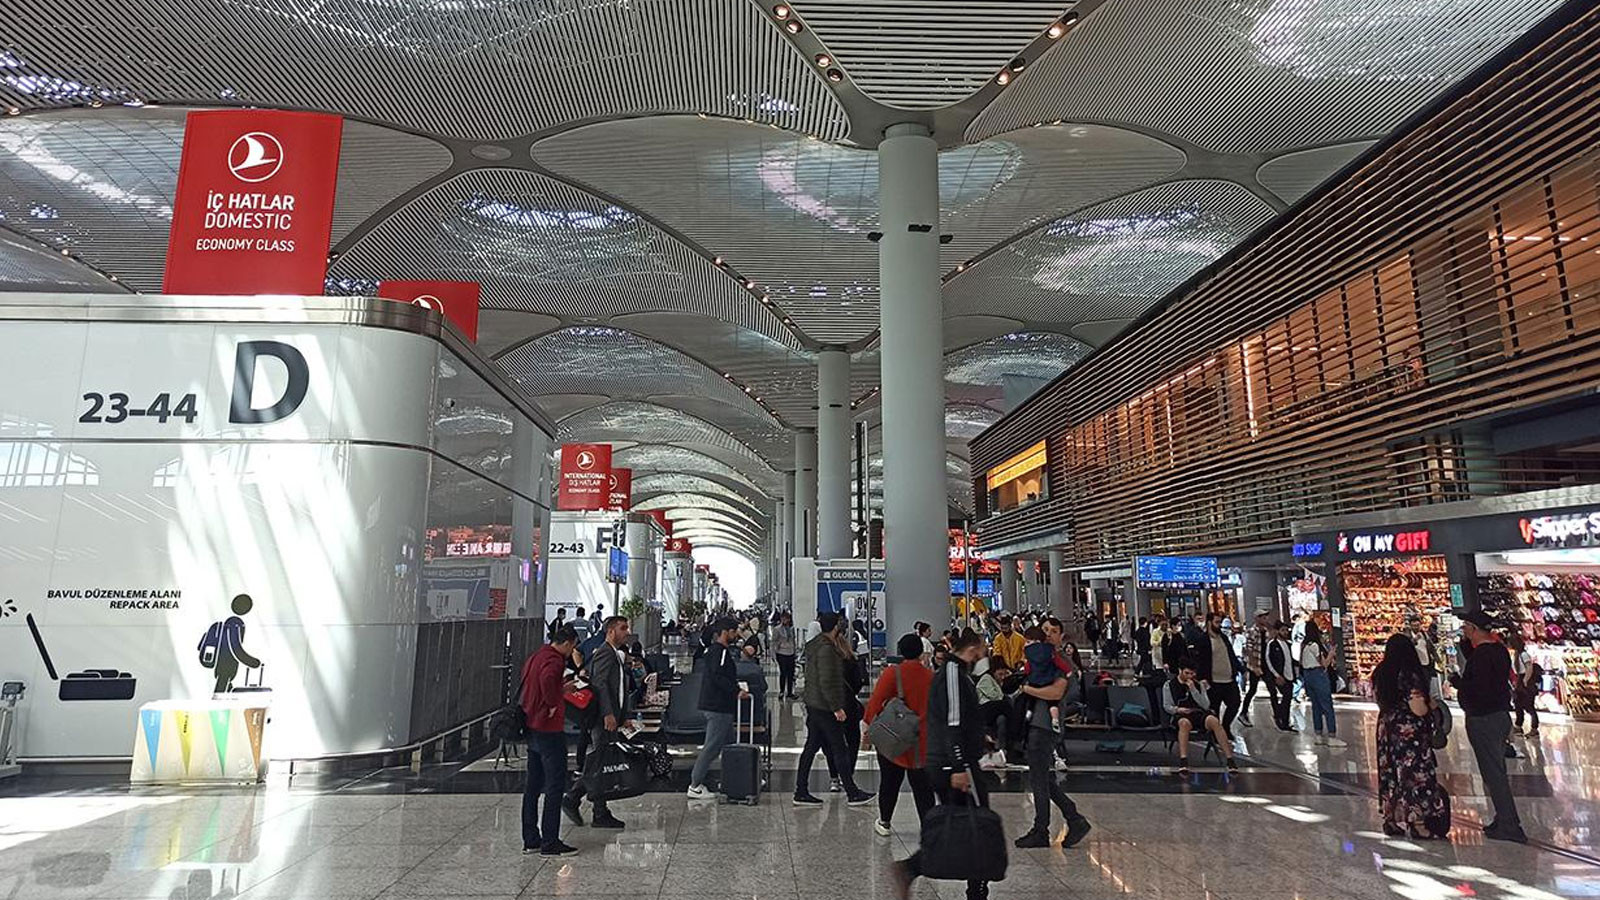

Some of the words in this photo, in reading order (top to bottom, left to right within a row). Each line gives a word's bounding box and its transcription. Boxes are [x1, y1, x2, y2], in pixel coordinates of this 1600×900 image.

[206, 189, 222, 212] İÇ
[227, 193, 295, 211] HATLAR
[204, 212, 292, 230] DOMESTIC
[196, 238, 253, 251] ECONOMY
[256, 239, 295, 252] CLASS
[228, 340, 310, 424] D
[78, 392, 198, 423] 23-44
[564, 472, 607, 480] INTERNATIONAL
[550, 543, 584, 553] 22-43
[1353, 535, 1371, 553] OH
[1374, 534, 1394, 552] MY
[1395, 531, 1429, 552] GIFT
[832, 571, 860, 579] GLOBAL
[47, 590, 83, 599] BAVUL
[84, 588, 148, 599] DÜZENLEME
[150, 590, 181, 599] ALANI
[110, 600, 150, 609] REPACK
[152, 600, 179, 609] AREA
